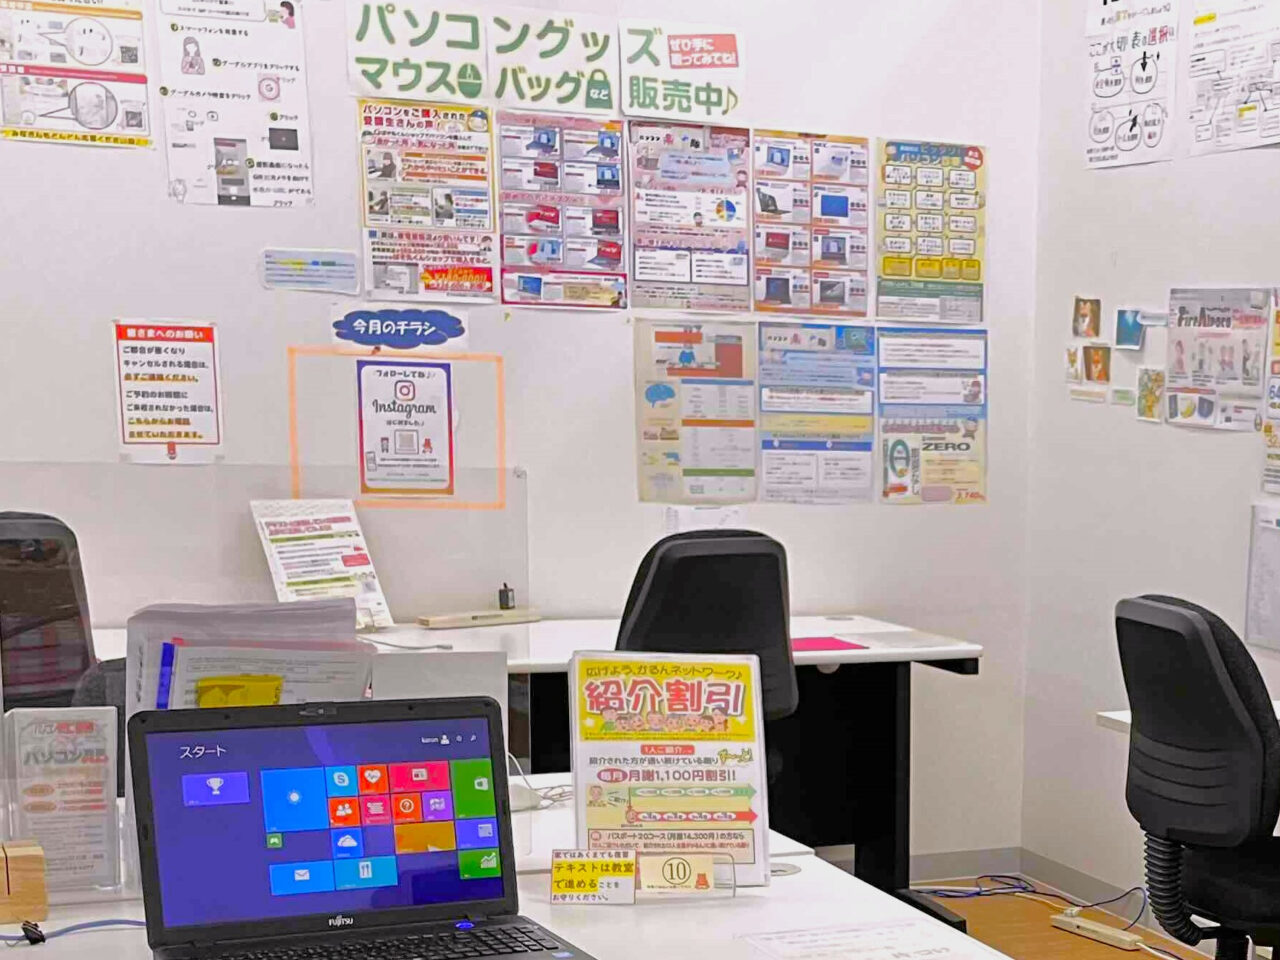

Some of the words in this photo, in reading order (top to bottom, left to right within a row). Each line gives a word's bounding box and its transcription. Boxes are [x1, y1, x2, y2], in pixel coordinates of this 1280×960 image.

[355, 3, 664, 67] パソコングッズ
[355, 56, 457, 96] マウス
[494, 66, 587, 105] バッグ
[629, 75, 723, 116] 販売中
[353, 318, 437, 336] 今月のチラシ
[372, 399, 437, 419] Instagram
[922, 442, 970, 452] ZERO
[584, 678, 744, 715] 紹介割引
[179, 744, 227, 760] スタート
[554, 862, 634, 874] テキストは教室
